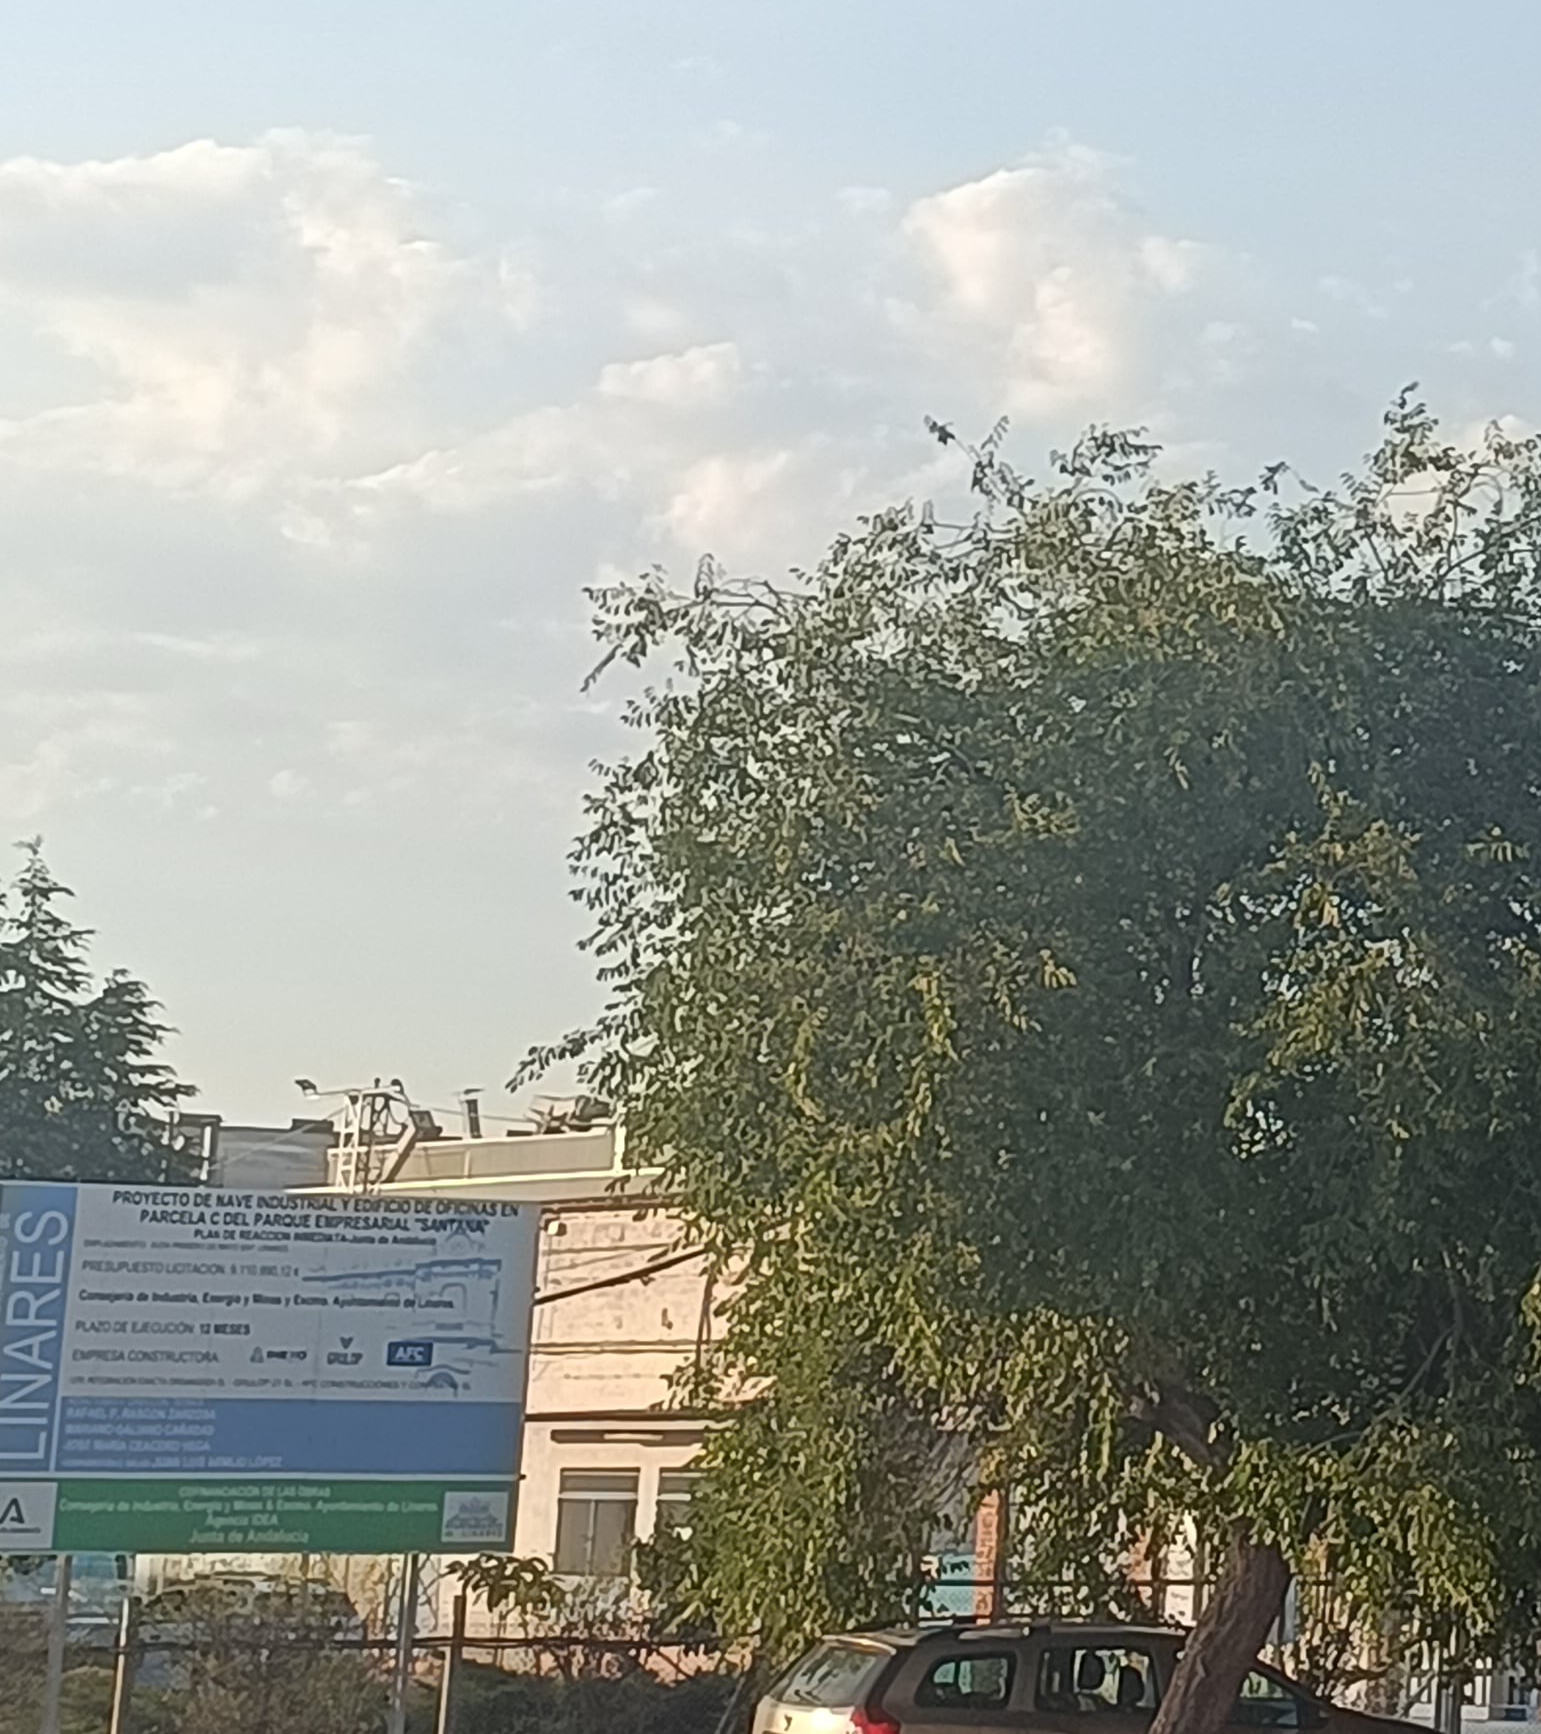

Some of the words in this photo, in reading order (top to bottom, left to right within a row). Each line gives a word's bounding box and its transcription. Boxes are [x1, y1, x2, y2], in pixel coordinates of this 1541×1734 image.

[112, 1190, 190, 1207] PROYECTO
[193, 1193, 212, 1208] DE
[216, 1194, 254, 1209] NAVE
[256, 1195, 337, 1212] INDUSTRIAL
[341, 1198, 350, 1212] Y
[354, 1198, 411, 1214] EDIFICIO
[414, 1200, 432, 1214] DE
[436, 1200, 498, 1217] OFICINAS
[501, 1203, 520, 1217] EN
[140, 1209, 206, 1225] PARCELA
[209, 1211, 221, 1225] C
[223, 1212, 250, 1226] DEL
[253, 1213, 311, 1229] PARQUE
[315, 1215, 411, 1232] EMPRESARIAL
[223, 1229, 236, 1240] DE
[81, 1259, 164, 1275] PRESUPUESTO
[136, 1291, 149, 1302] de
[242, 1294, 250, 1307] y
[285, 1296, 291, 1308] y
[403, 1298, 416, 1309] de
[0, 1210, 69, 1459] LINARES
[75, 1320, 111, 1334] PLAZO
[113, 1321, 128, 1334] DE
[200, 1323, 211, 1335] 12
[213, 1323, 251, 1336] MESES
[72, 1348, 126, 1362] EMPRESA
[127, 1349, 219, 1364] CONSTRUCTORA
[117, 1501, 130, 1512] de
[387, 1501, 399, 1512] de
[250, 1514, 278, 1525] IDEA
[189, 1530, 225, 1544] Junta
[227, 1531, 244, 1543] de
